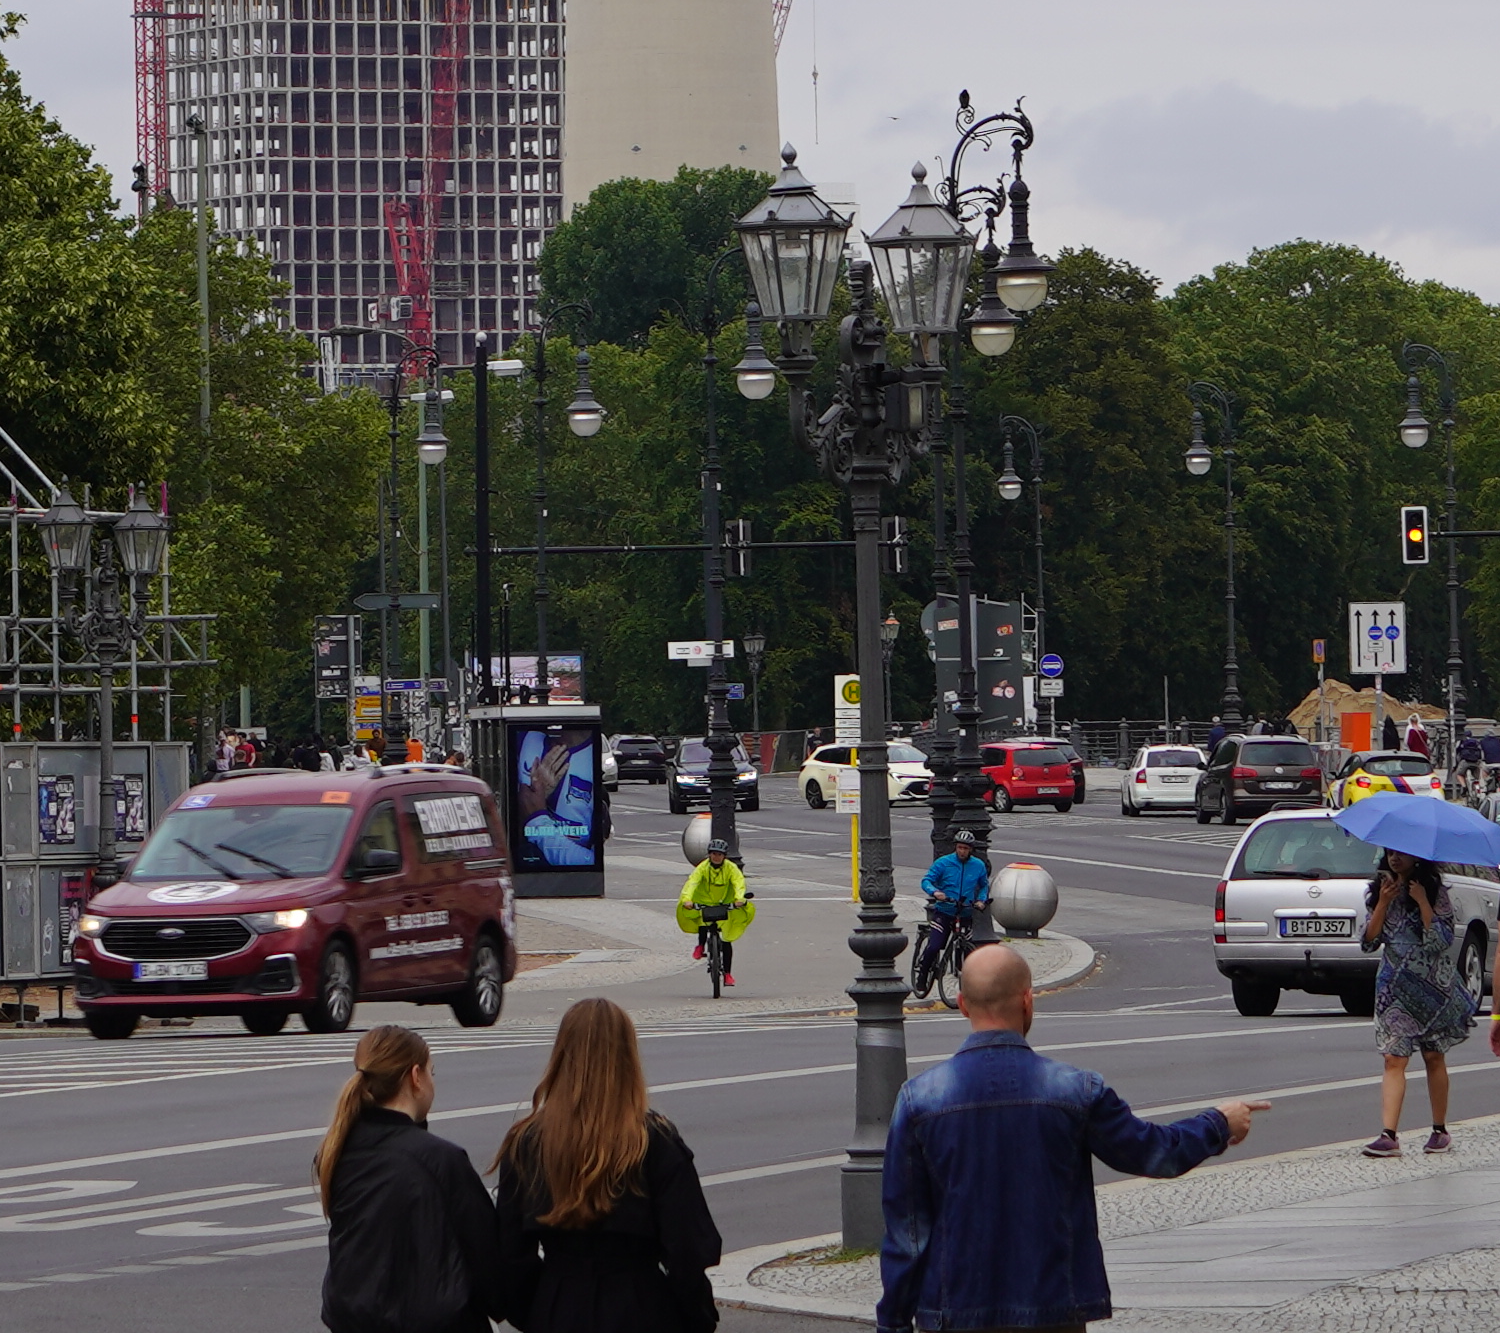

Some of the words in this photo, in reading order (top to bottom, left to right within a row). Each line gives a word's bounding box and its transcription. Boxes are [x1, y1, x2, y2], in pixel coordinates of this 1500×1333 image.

[1291, 920, 1299, 933] B
[1306, 920, 1321, 933] FD
[1323, 920, 1346, 933] 357
